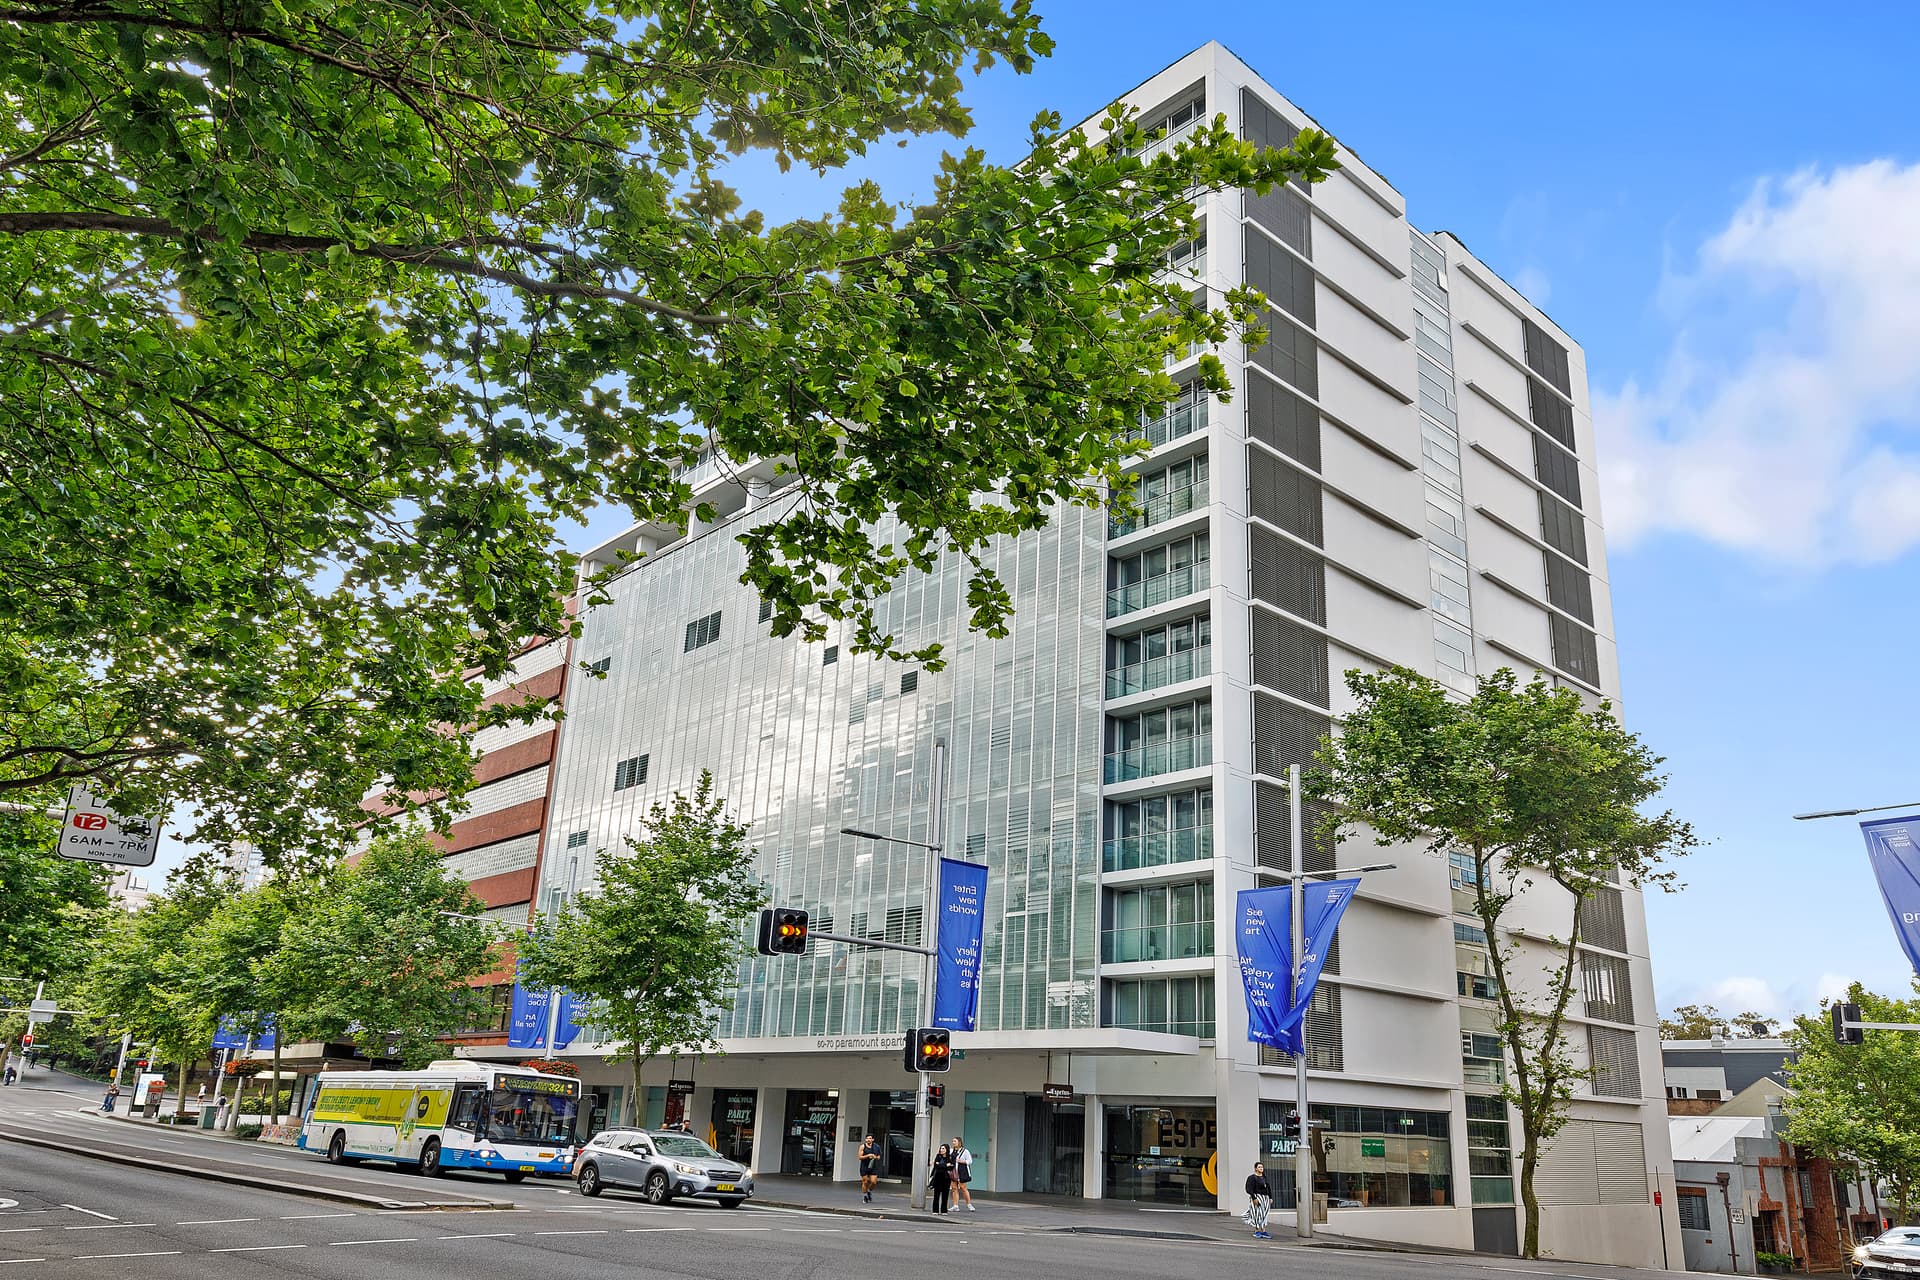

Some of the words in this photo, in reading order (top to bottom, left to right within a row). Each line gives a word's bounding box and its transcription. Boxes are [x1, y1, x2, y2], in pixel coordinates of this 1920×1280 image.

[79, 814, 104, 830] T2
[70, 835, 102, 847] 6AM
[119, 840, 148, 852] 7PM
[1246, 908, 1263, 916] See
[1246, 918, 1265, 926] new
[1245, 927, 1260, 935] art
[835, 1037, 879, 1050] paramount
[880, 1037, 906, 1049] apart
[549, 1082, 565, 1093] 324
[727, 1109, 752, 1121] PARTY
[809, 1113, 836, 1125] PARTY
[1269, 1123, 1283, 1131] BOO
[1158, 1118, 1216, 1149] ESPE
[1271, 1140, 1297, 1153] PART
